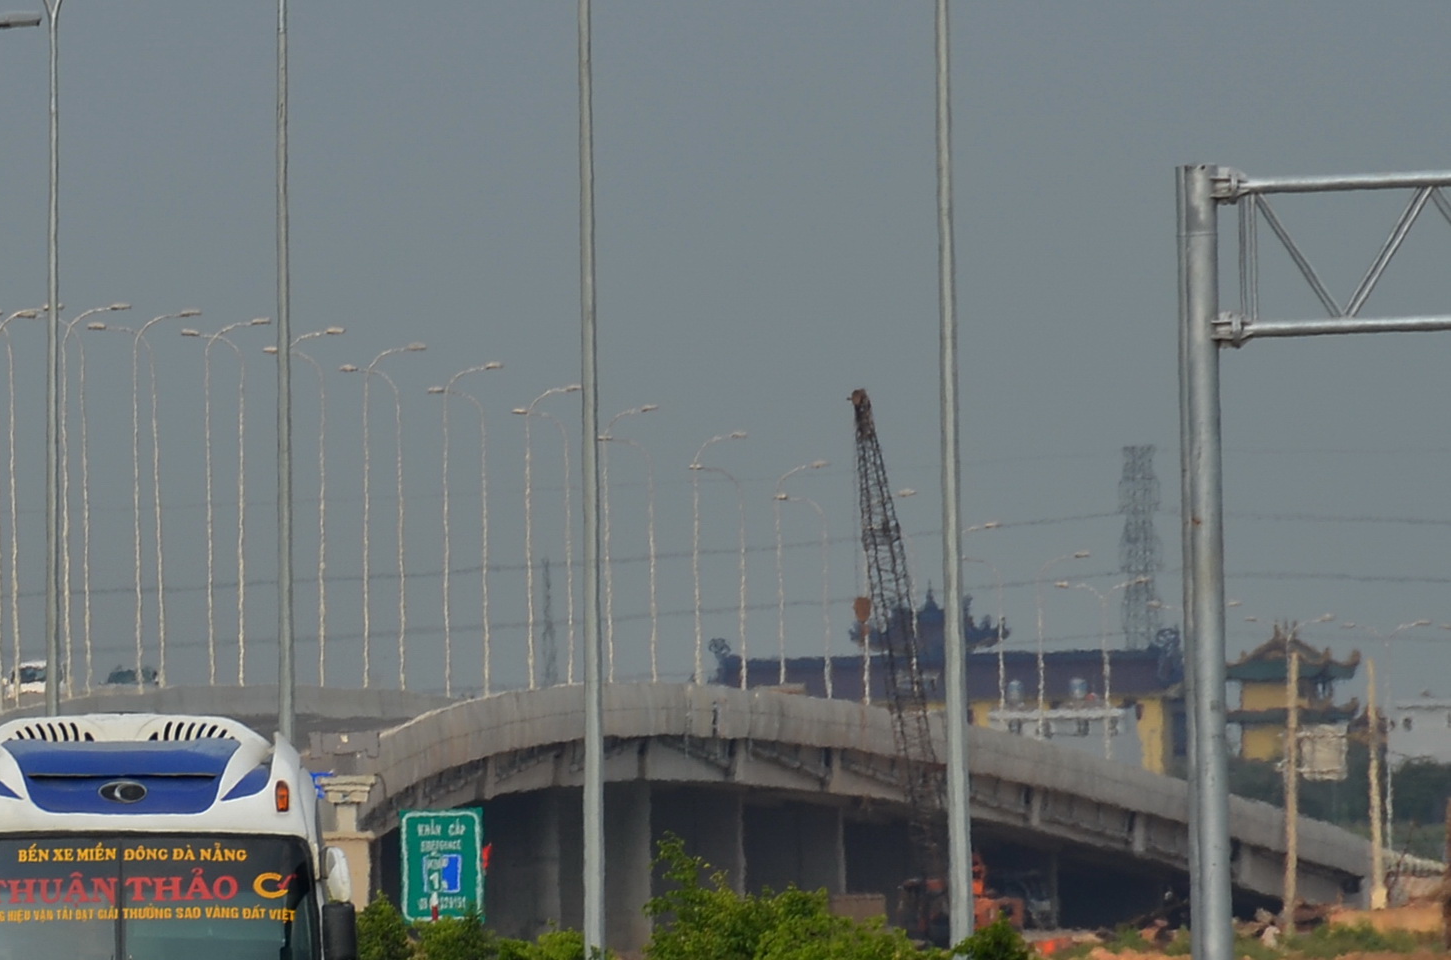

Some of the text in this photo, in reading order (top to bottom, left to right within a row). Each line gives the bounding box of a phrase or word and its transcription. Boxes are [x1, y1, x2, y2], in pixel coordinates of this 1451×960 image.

[17, 843, 50, 863] BẾN
[52, 847, 75, 862] XE
[123, 844, 169, 861] ĐÔNG
[172, 843, 196, 861] ĐÀ
[124, 866, 239, 902] THẢO
[175, 906, 202, 920] SAO
[205, 904, 240, 920] VÀNG
[242, 903, 266, 920] ĐẤT
